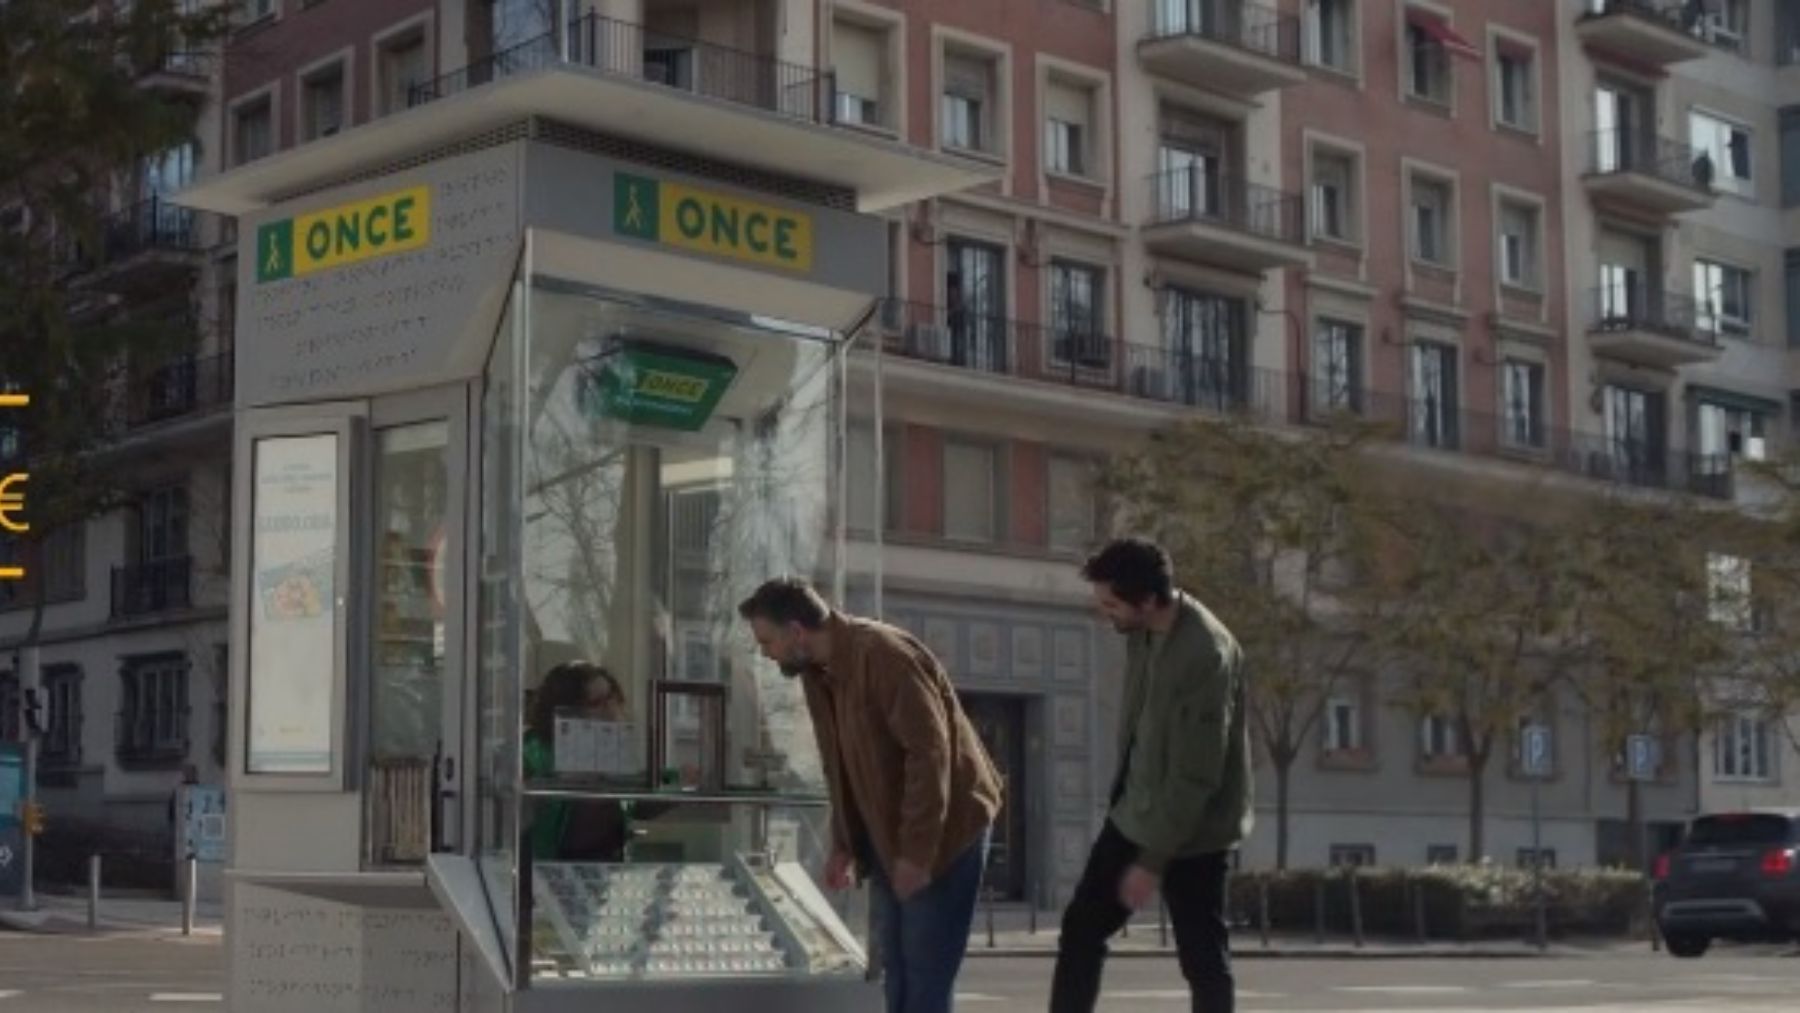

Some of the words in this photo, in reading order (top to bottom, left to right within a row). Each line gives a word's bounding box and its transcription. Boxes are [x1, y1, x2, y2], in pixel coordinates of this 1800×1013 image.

[307, 197, 415, 261] ONCE
[676, 197, 798, 260] ONCE
[648, 375, 702, 396] ONCE
